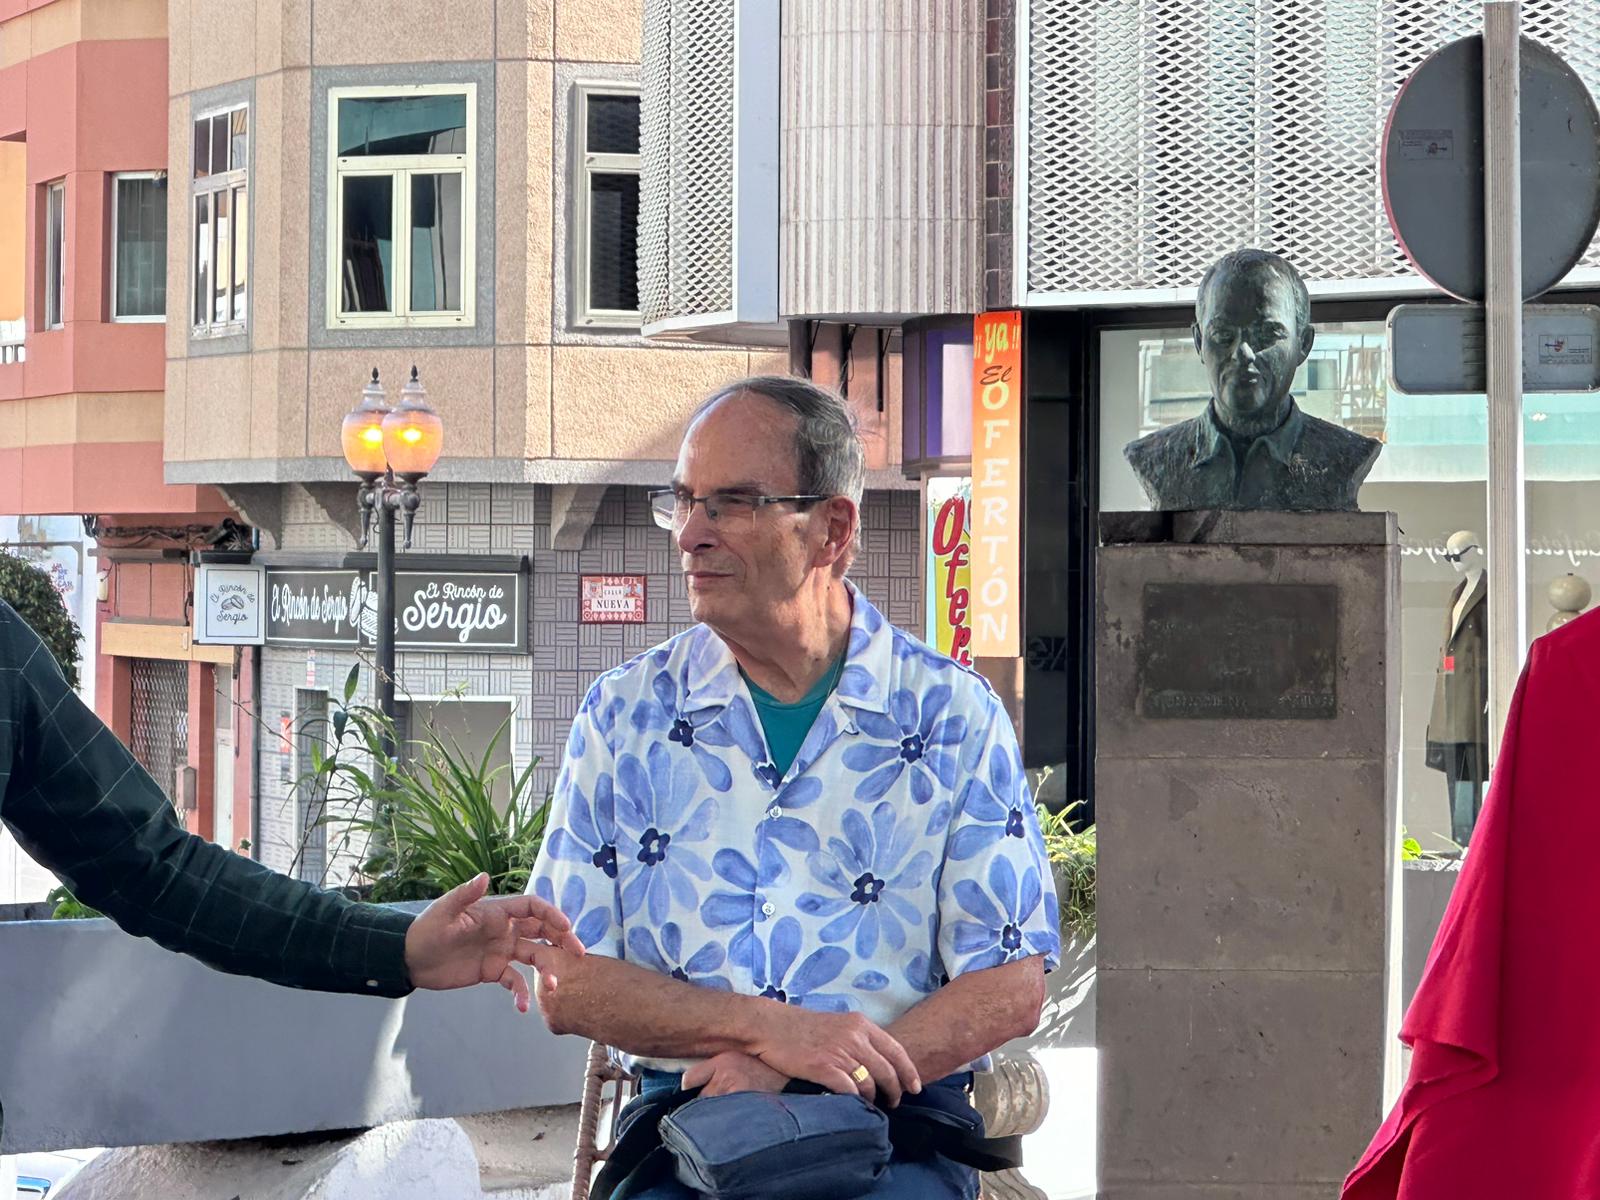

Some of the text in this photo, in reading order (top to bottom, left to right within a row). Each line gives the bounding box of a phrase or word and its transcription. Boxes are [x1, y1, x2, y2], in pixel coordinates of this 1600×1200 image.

[979, 365, 1012, 385] El
[979, 380, 1010, 642] OFERTÓN
[426, 582, 504, 600] El Rincón de
[271, 583, 348, 634] El Rincón de Sergio
[596, 599, 630, 609] NUEVA
[216, 609, 248, 624] Sergio
[402, 590, 507, 643] Sergio
